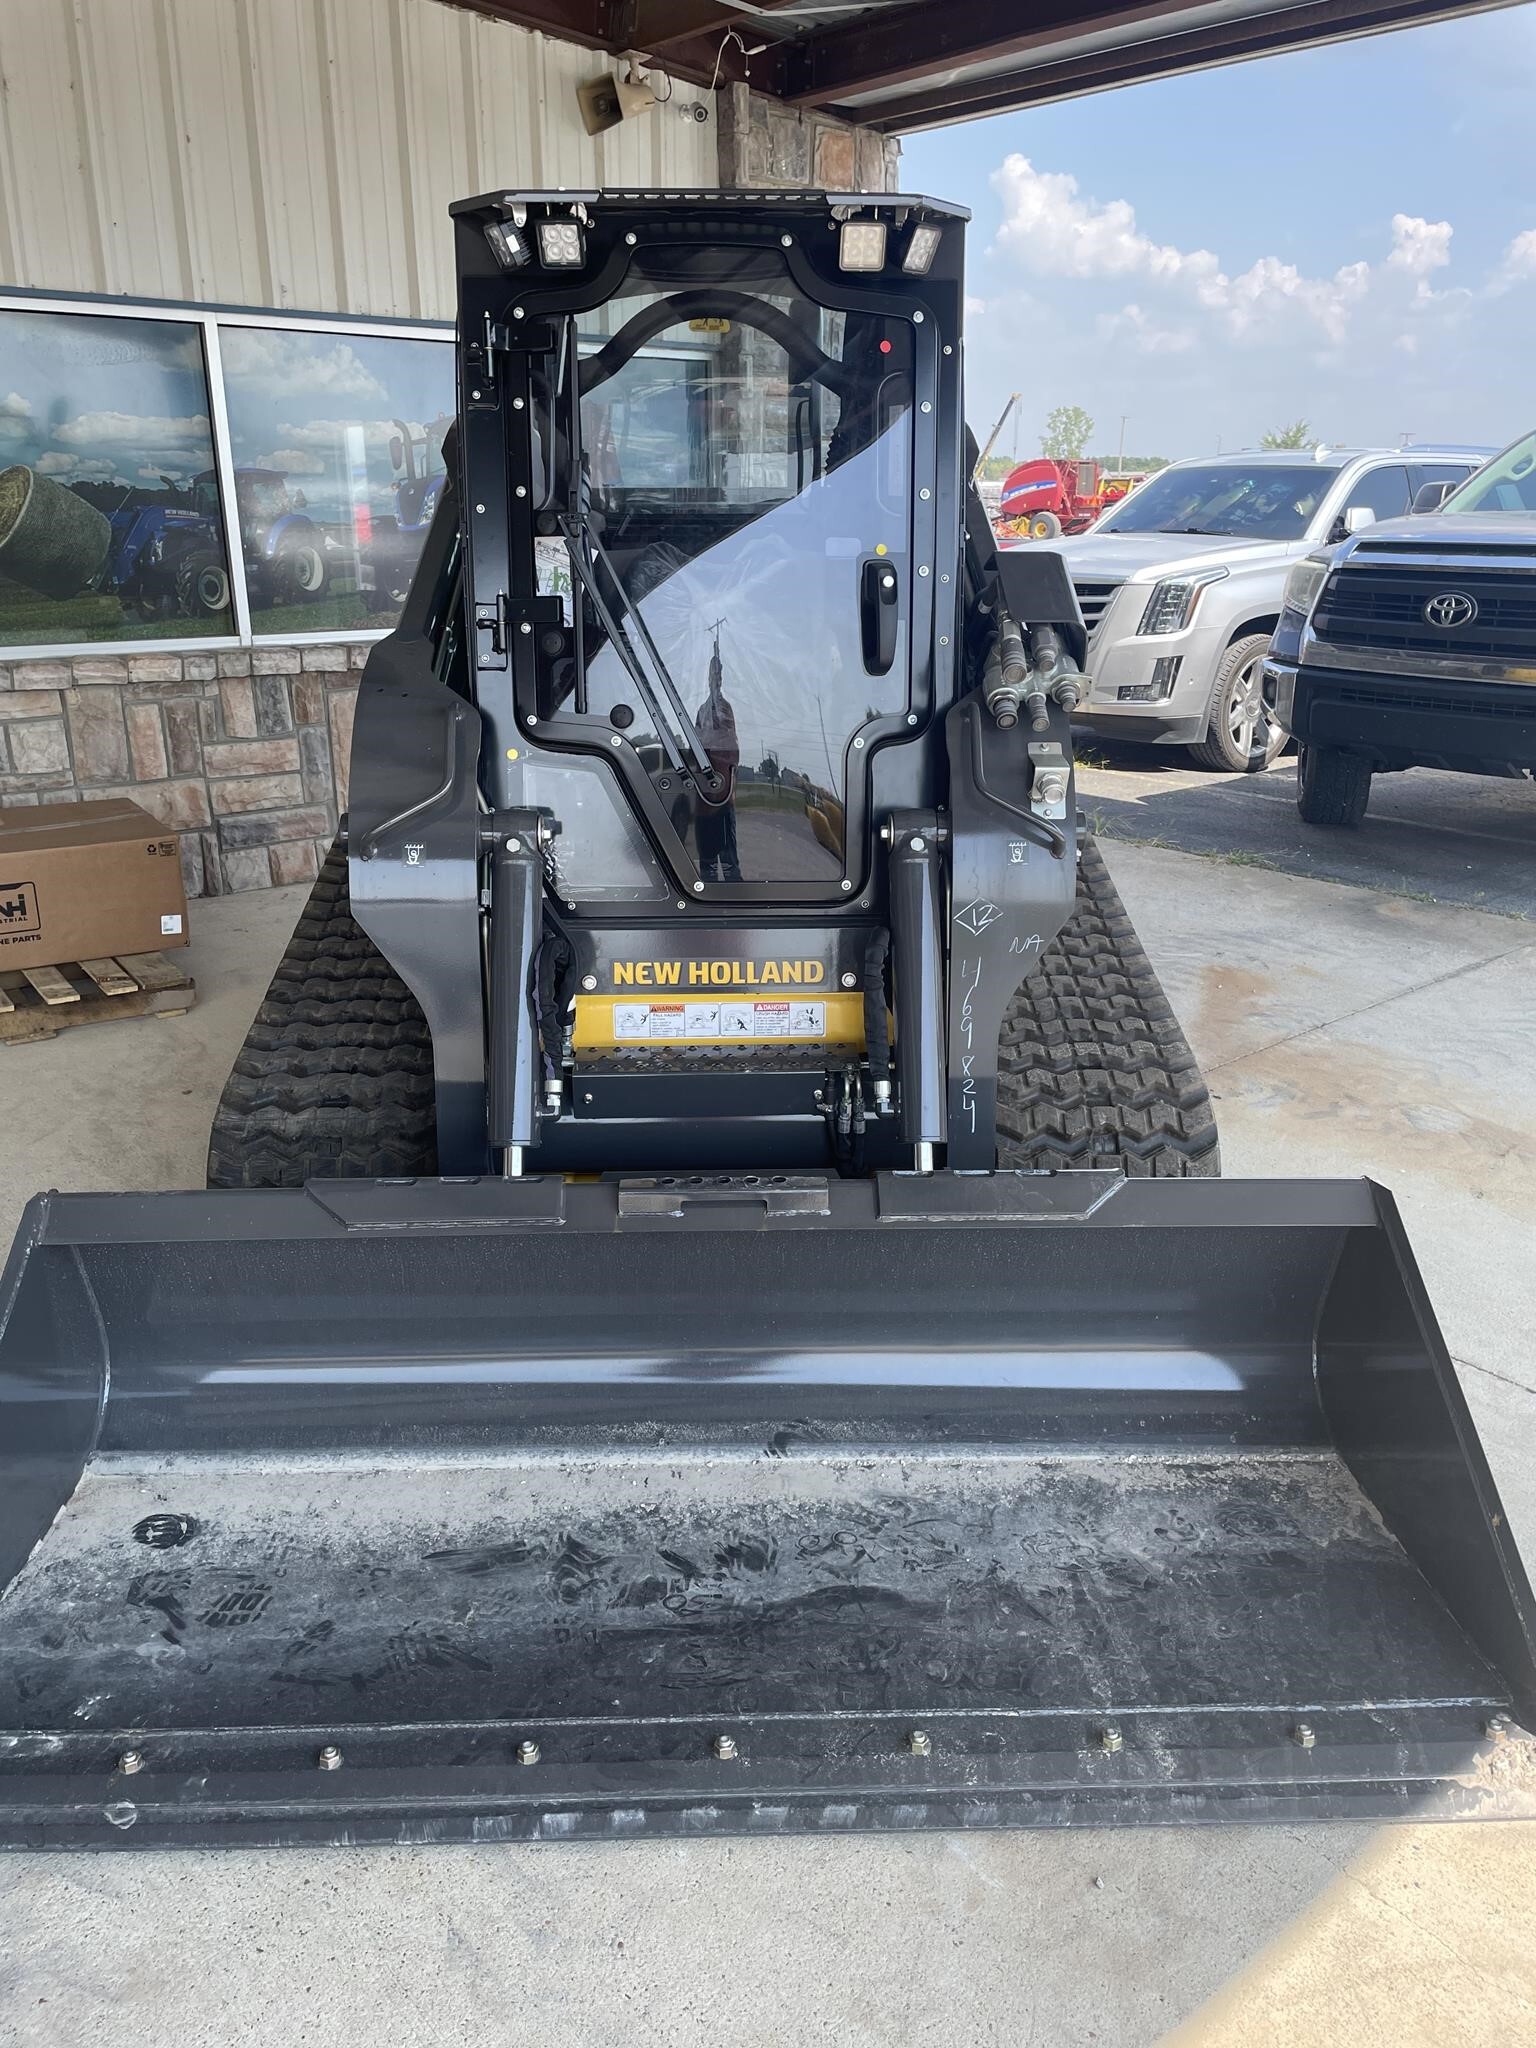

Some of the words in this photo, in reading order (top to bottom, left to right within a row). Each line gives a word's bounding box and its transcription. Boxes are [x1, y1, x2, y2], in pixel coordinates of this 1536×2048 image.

[972, 904, 993, 927] 12
[12, 934, 41, 944] PARTS
[613, 962, 682, 985] NEW
[688, 960, 825, 985] HOLLAND
